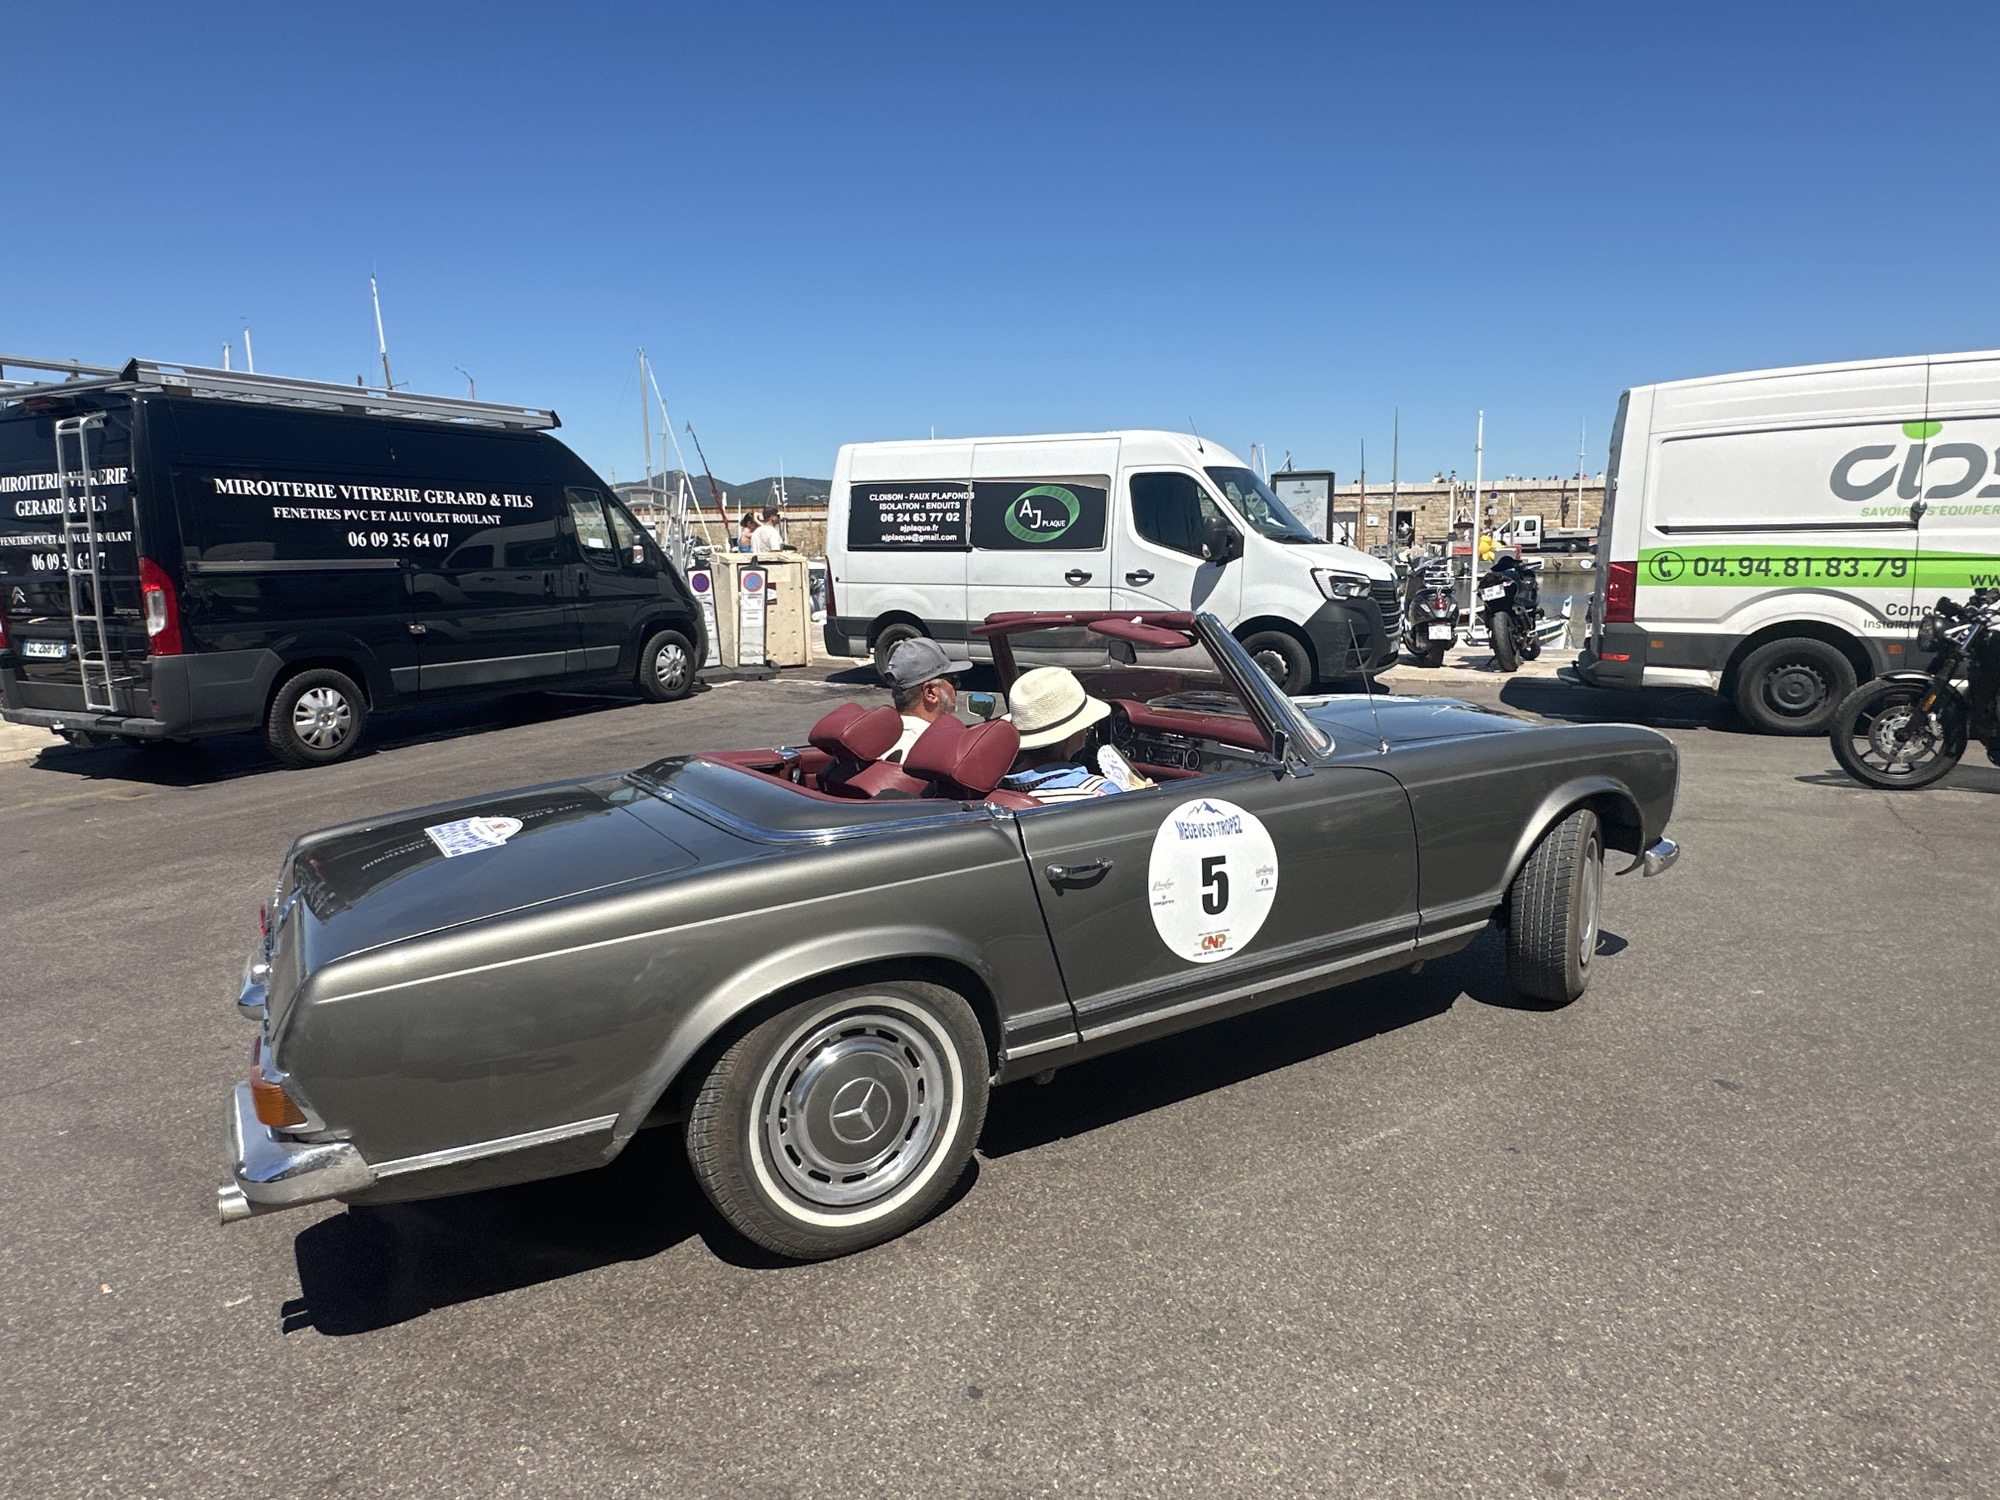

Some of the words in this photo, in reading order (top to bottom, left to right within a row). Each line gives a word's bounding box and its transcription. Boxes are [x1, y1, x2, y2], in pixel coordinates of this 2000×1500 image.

[68, 467, 128, 487] VIRERIE
[214, 478, 337, 499] MIROITERIE
[339, 485, 421, 503] VITRERIE
[424, 489, 487, 506] GERARD
[490, 493, 501, 507] &
[503, 494, 534, 508] FILS
[931, 491, 975, 500] PLAFONDS
[15, 498, 64, 517] GERARD
[68, 497, 77, 513] &
[79, 495, 107, 513] FLS
[273, 506, 341, 520] FENETRES
[343, 509, 369, 521] PVC
[371, 510, 386, 521] ET
[388, 511, 412, 522] ALU
[413, 511, 450, 523] VOLET
[452, 513, 501, 525] ROULANT
[880, 513, 894, 522] 06
[896, 513, 910, 522] 24
[912, 513, 926, 522] 63
[929, 513, 943, 522] 77
[946, 512, 960, 522] 02
[1042, 520, 1066, 528] PLAQUE
[899, 524, 939, 533] ajplaque.fr
[33, 534, 48, 545] PVC
[48, 534, 57, 545] ET
[58, 533, 67, 544] AL
[72, 532, 91, 543] VOLE
[348, 530, 368, 547] 06
[370, 532, 388, 547] 09
[392, 532, 410, 548] 35
[413, 533, 430, 548] 64
[433, 533, 449, 548] 07
[881, 533, 957, 543] ajplaque@gmail.com
[32, 553, 45, 571] 06
[46, 553, 59, 570] 09
[62, 552, 69, 570] 3
[98, 551, 105, 569] 7
[1693, 556, 1907, 578] 04.94.81.83.79
[1885, 603, 1936, 616] Conc
[1201, 855, 1229, 915] 5
